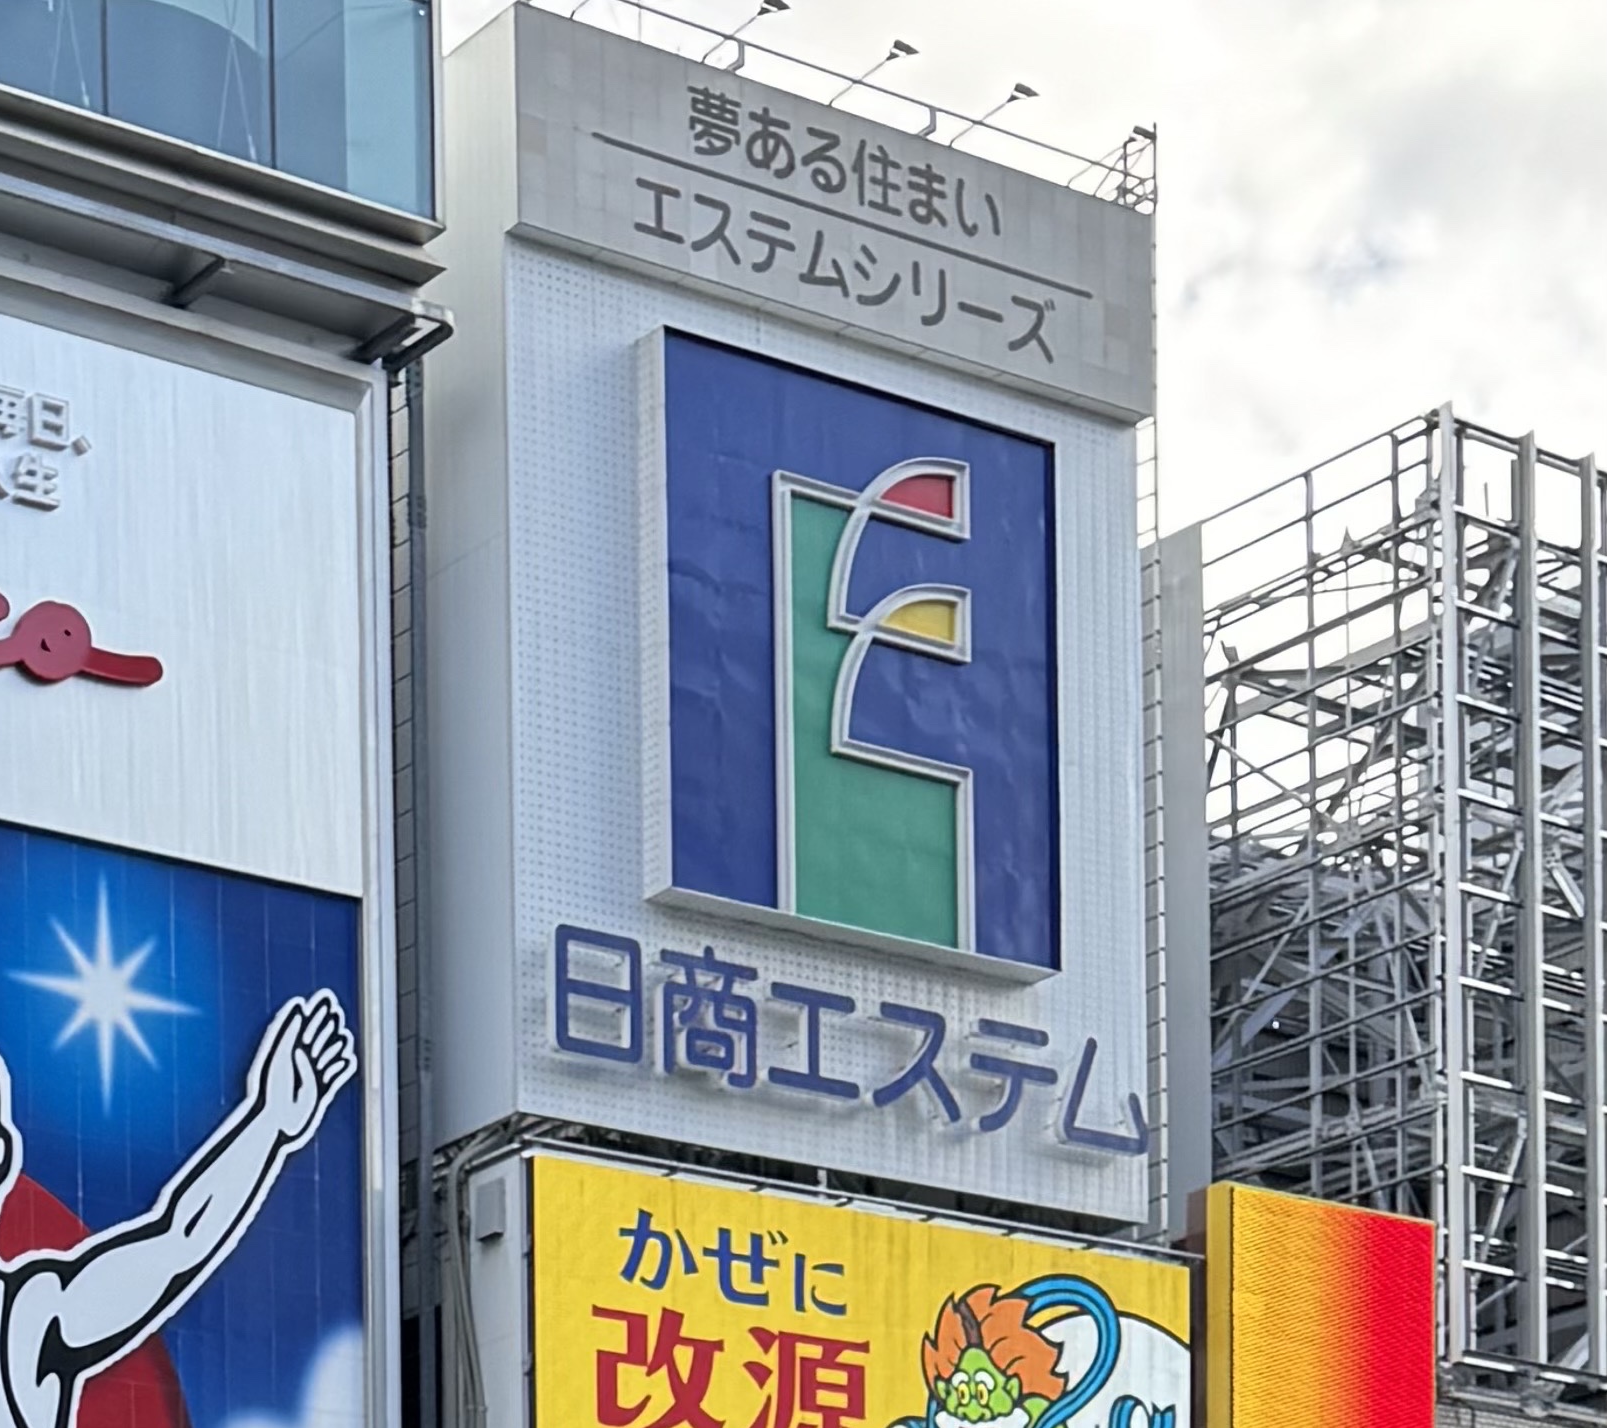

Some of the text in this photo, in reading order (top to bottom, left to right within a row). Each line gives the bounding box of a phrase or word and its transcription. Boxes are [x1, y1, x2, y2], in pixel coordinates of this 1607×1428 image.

[686, 86, 1001, 239] 夢ある住まい
[634, 177, 1055, 364] エステムシリーズ
[553, 922, 1150, 1157] 日商エステム
[618, 1208, 848, 1318] かぜに
